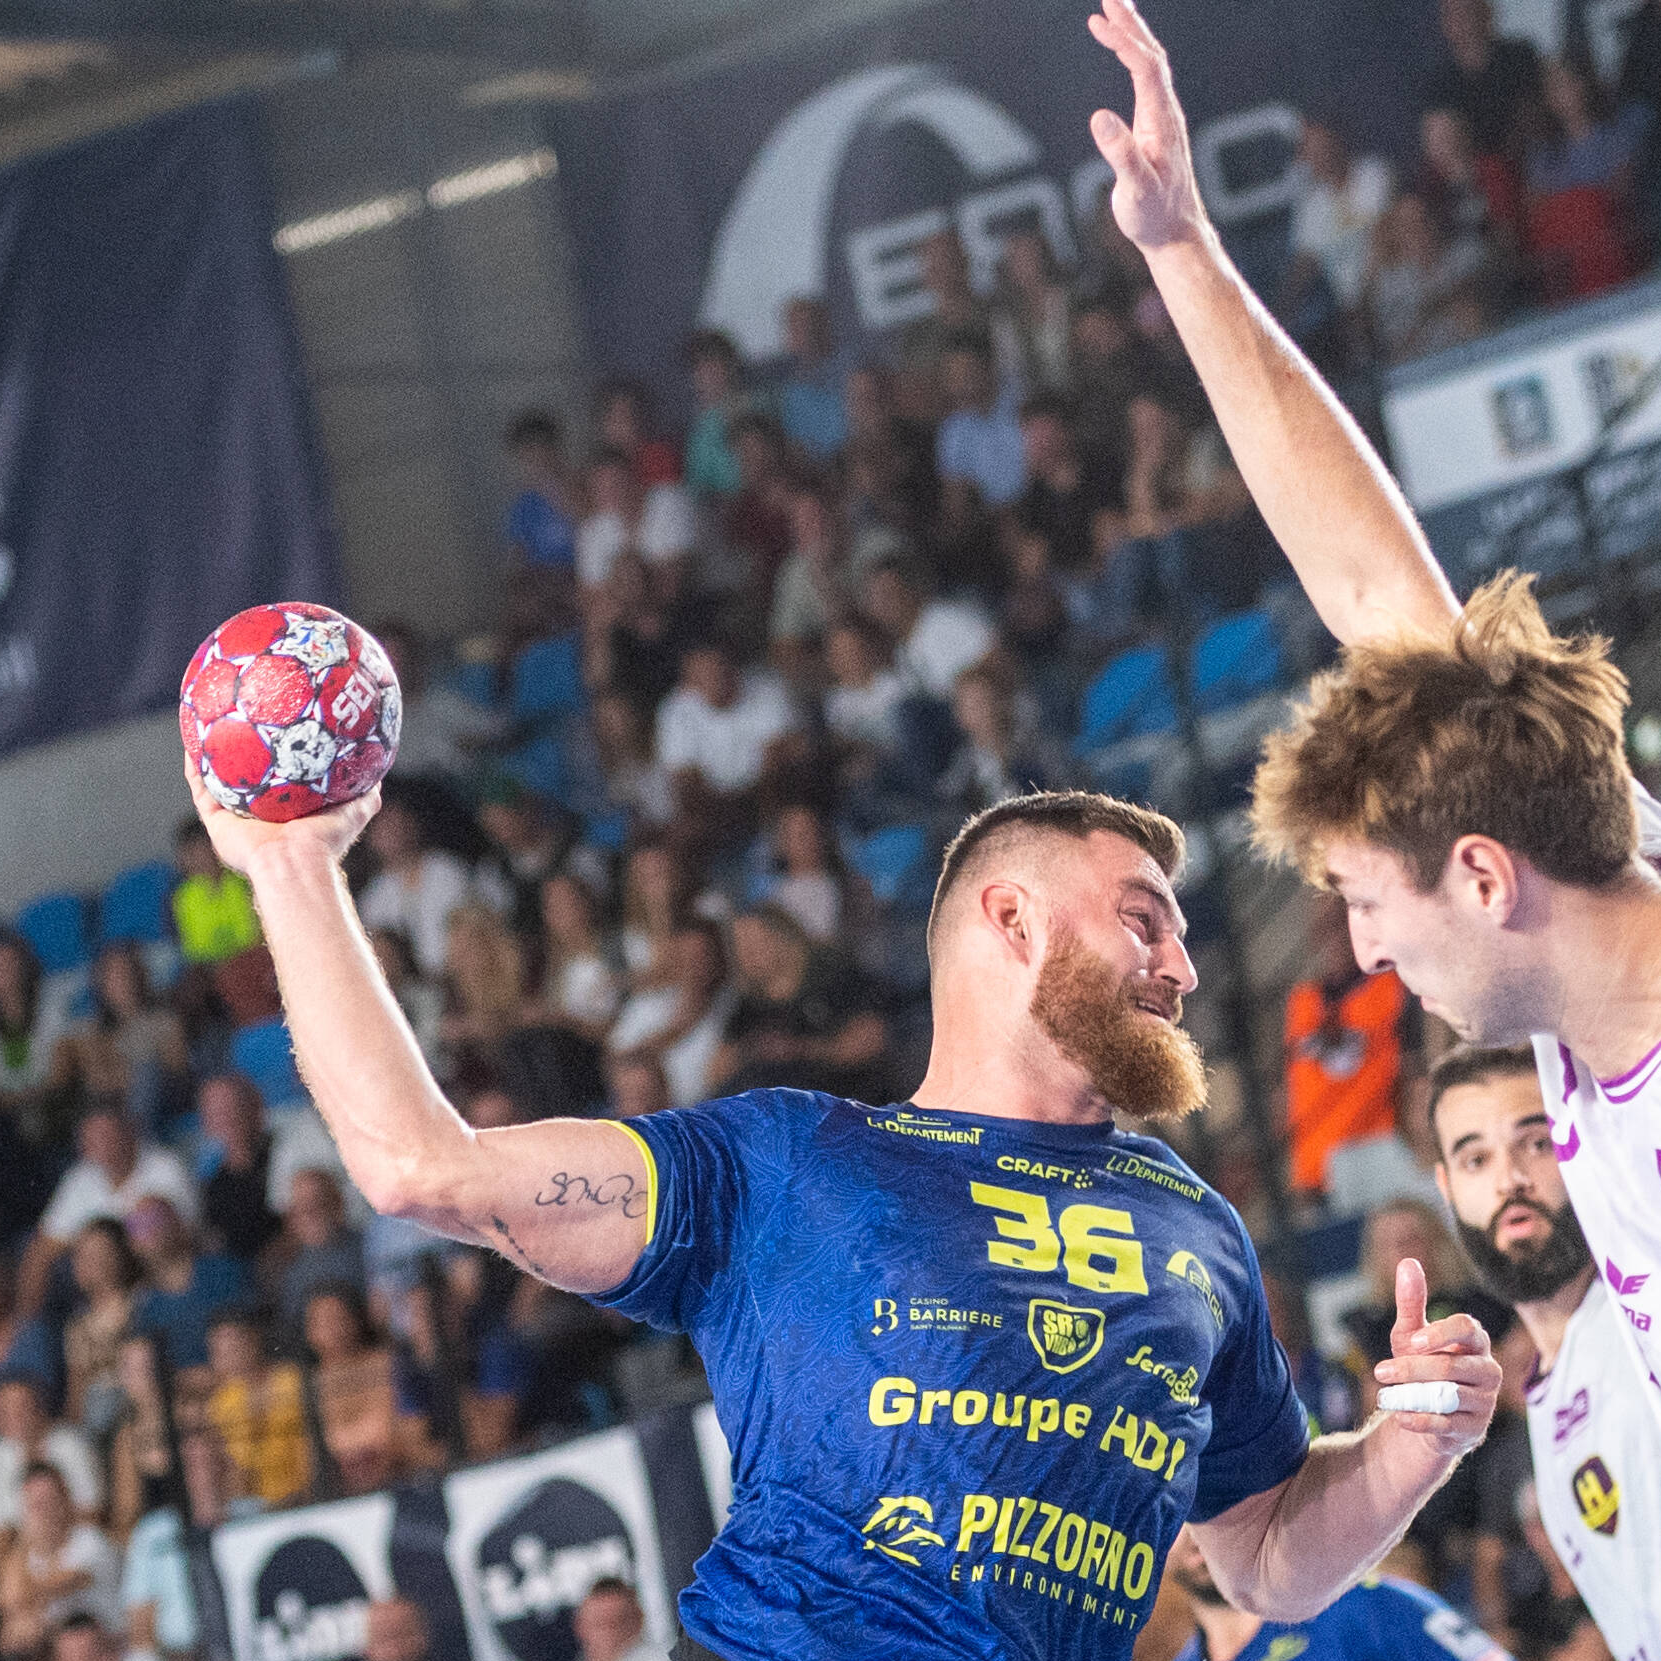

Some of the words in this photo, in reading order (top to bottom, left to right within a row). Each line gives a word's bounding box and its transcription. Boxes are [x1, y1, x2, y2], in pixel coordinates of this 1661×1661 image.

[847, 105, 1309, 325] ERC
[996, 1154, 1075, 1184] CRAFT
[969, 1180, 1149, 1297] 36
[909, 1297, 950, 1307] CASINO
[909, 1308, 1004, 1330] BARRIÈRE
[868, 1375, 1093, 1443] Groupe
[956, 1493, 1156, 1602] PIZZORNO
